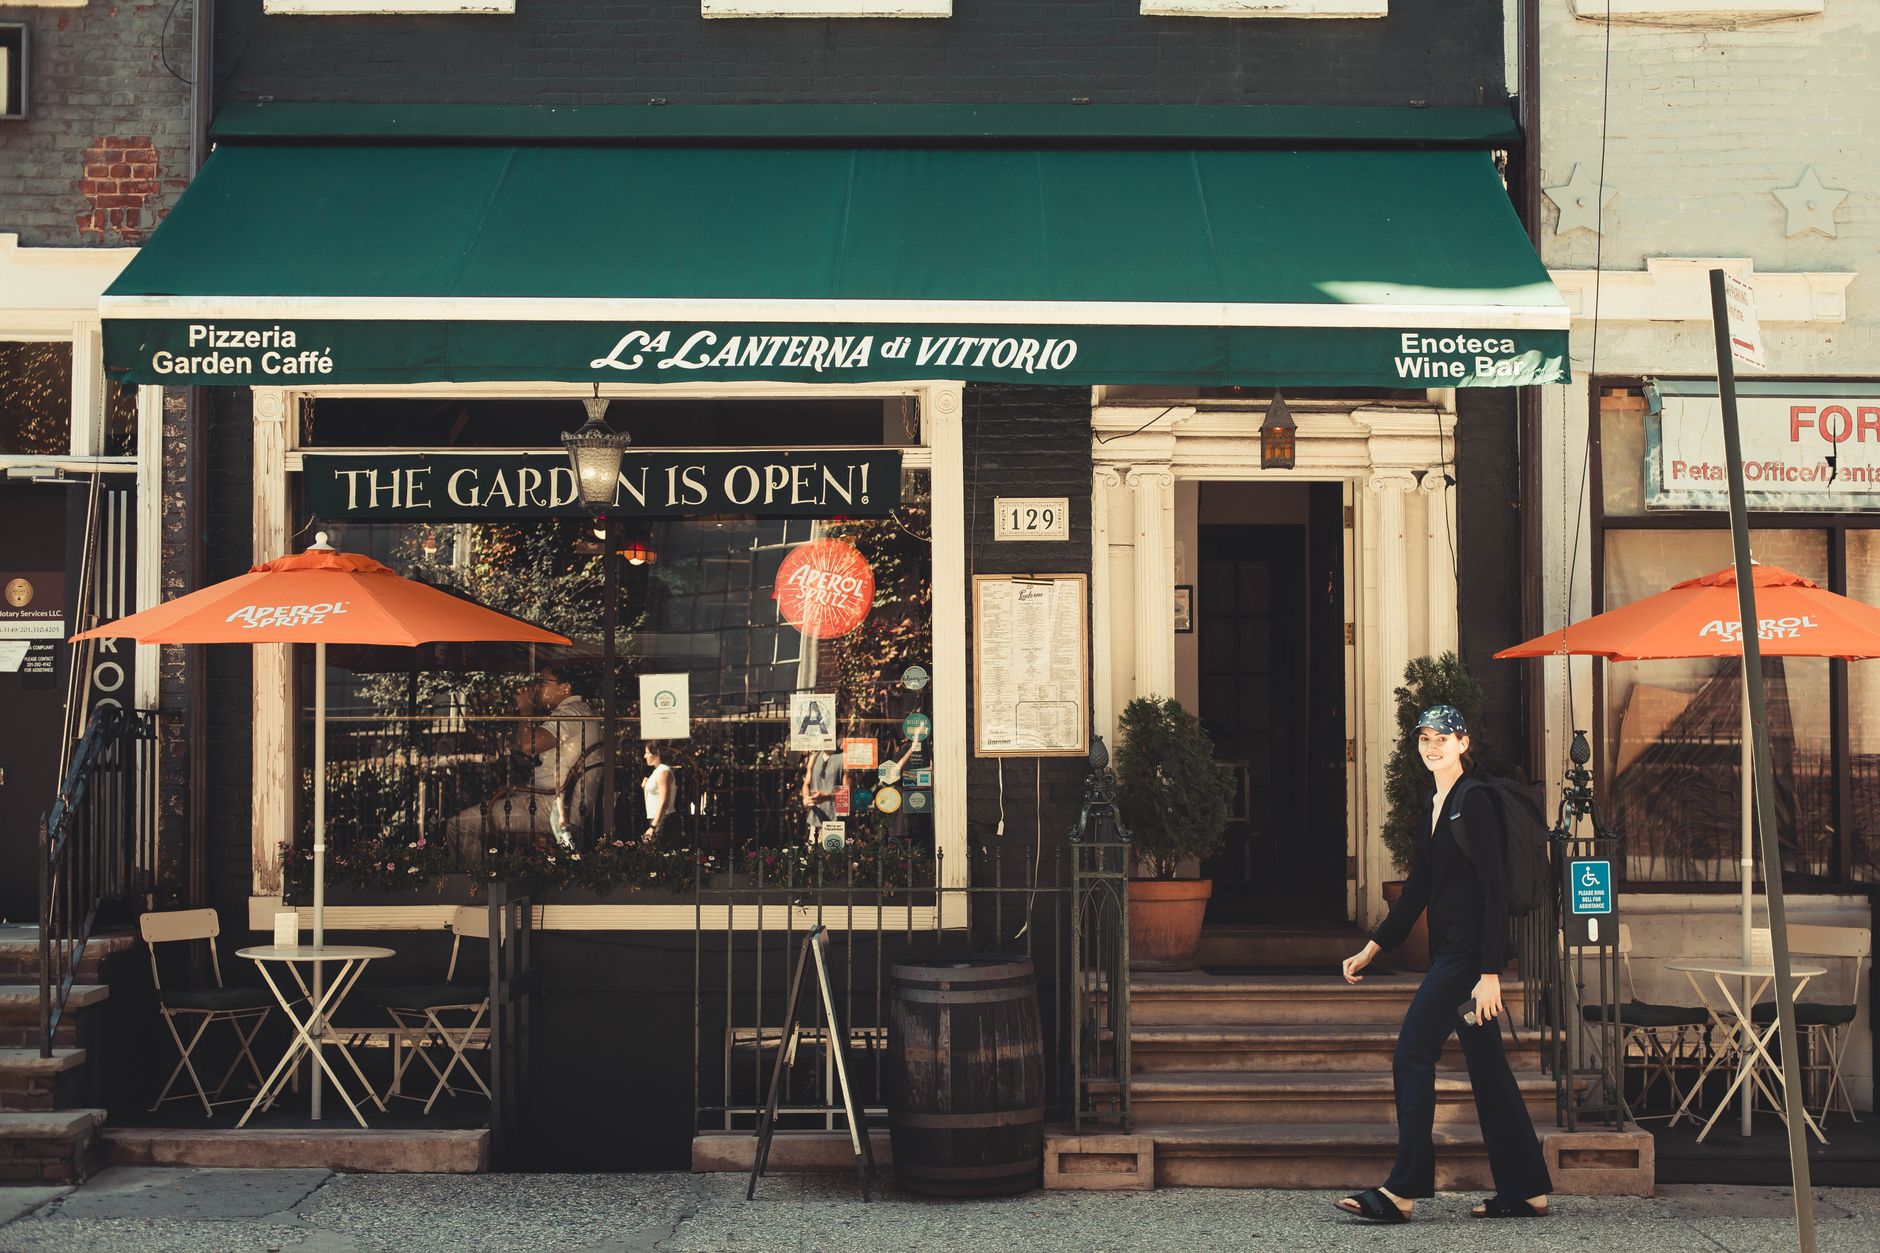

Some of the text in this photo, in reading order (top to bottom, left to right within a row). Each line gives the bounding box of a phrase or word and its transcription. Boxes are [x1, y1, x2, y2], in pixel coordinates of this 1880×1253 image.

[189, 324, 296, 348] Pizzeria
[1401, 333, 1516, 354] Enoteca
[152, 347, 333, 374] Garden Caffé
[657, 330, 874, 373] LANTERNA
[880, 336, 912, 359] di
[915, 336, 1078, 374] VITTORIO
[1394, 356, 1525, 378] Wine Bar
[1790, 405, 1880, 443] FOR
[335, 462, 870, 510] THE GARDN IS OPEN!
[1011, 508, 1054, 530] 129
[787, 564, 864, 597] APEROL
[225, 602, 348, 623] APEROL
[1699, 616, 1819, 636] APROL
[798, 701, 829, 735] A
